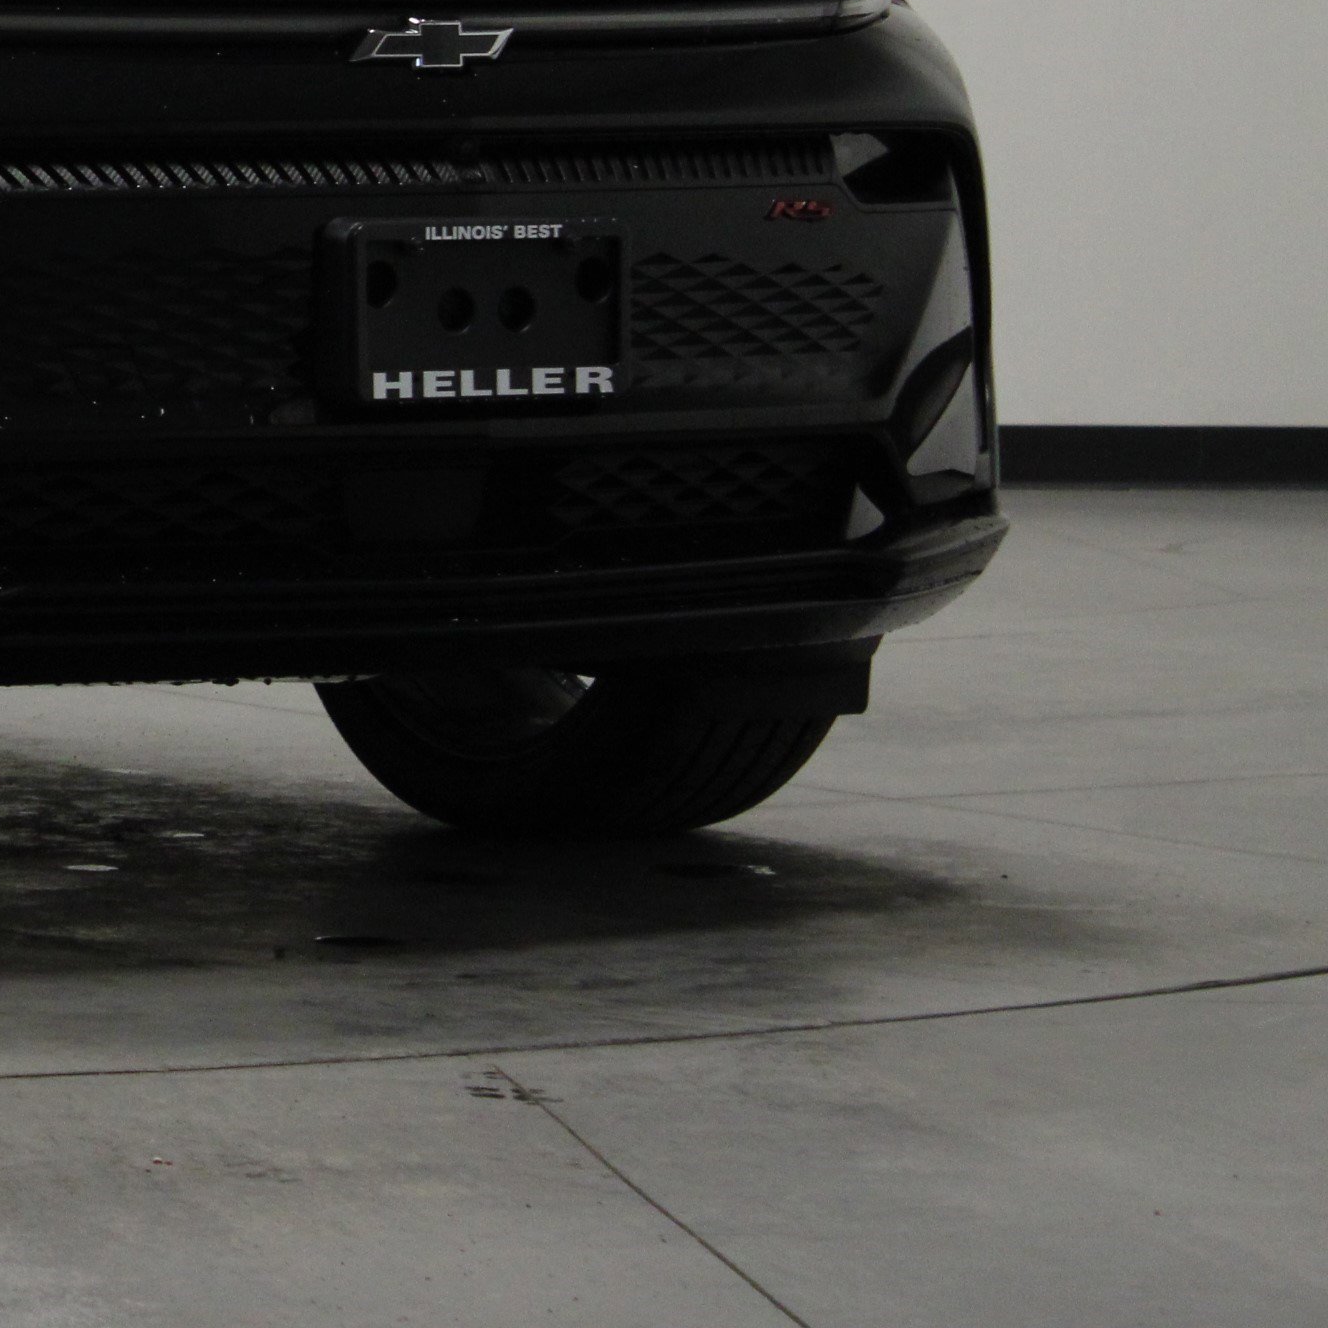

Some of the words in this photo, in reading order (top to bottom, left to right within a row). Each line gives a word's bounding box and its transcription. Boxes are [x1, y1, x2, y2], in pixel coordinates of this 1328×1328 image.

[424, 224, 509, 241] ILLINOIS'
[513, 223, 563, 240] BEST
[371, 365, 615, 401] HELLER
